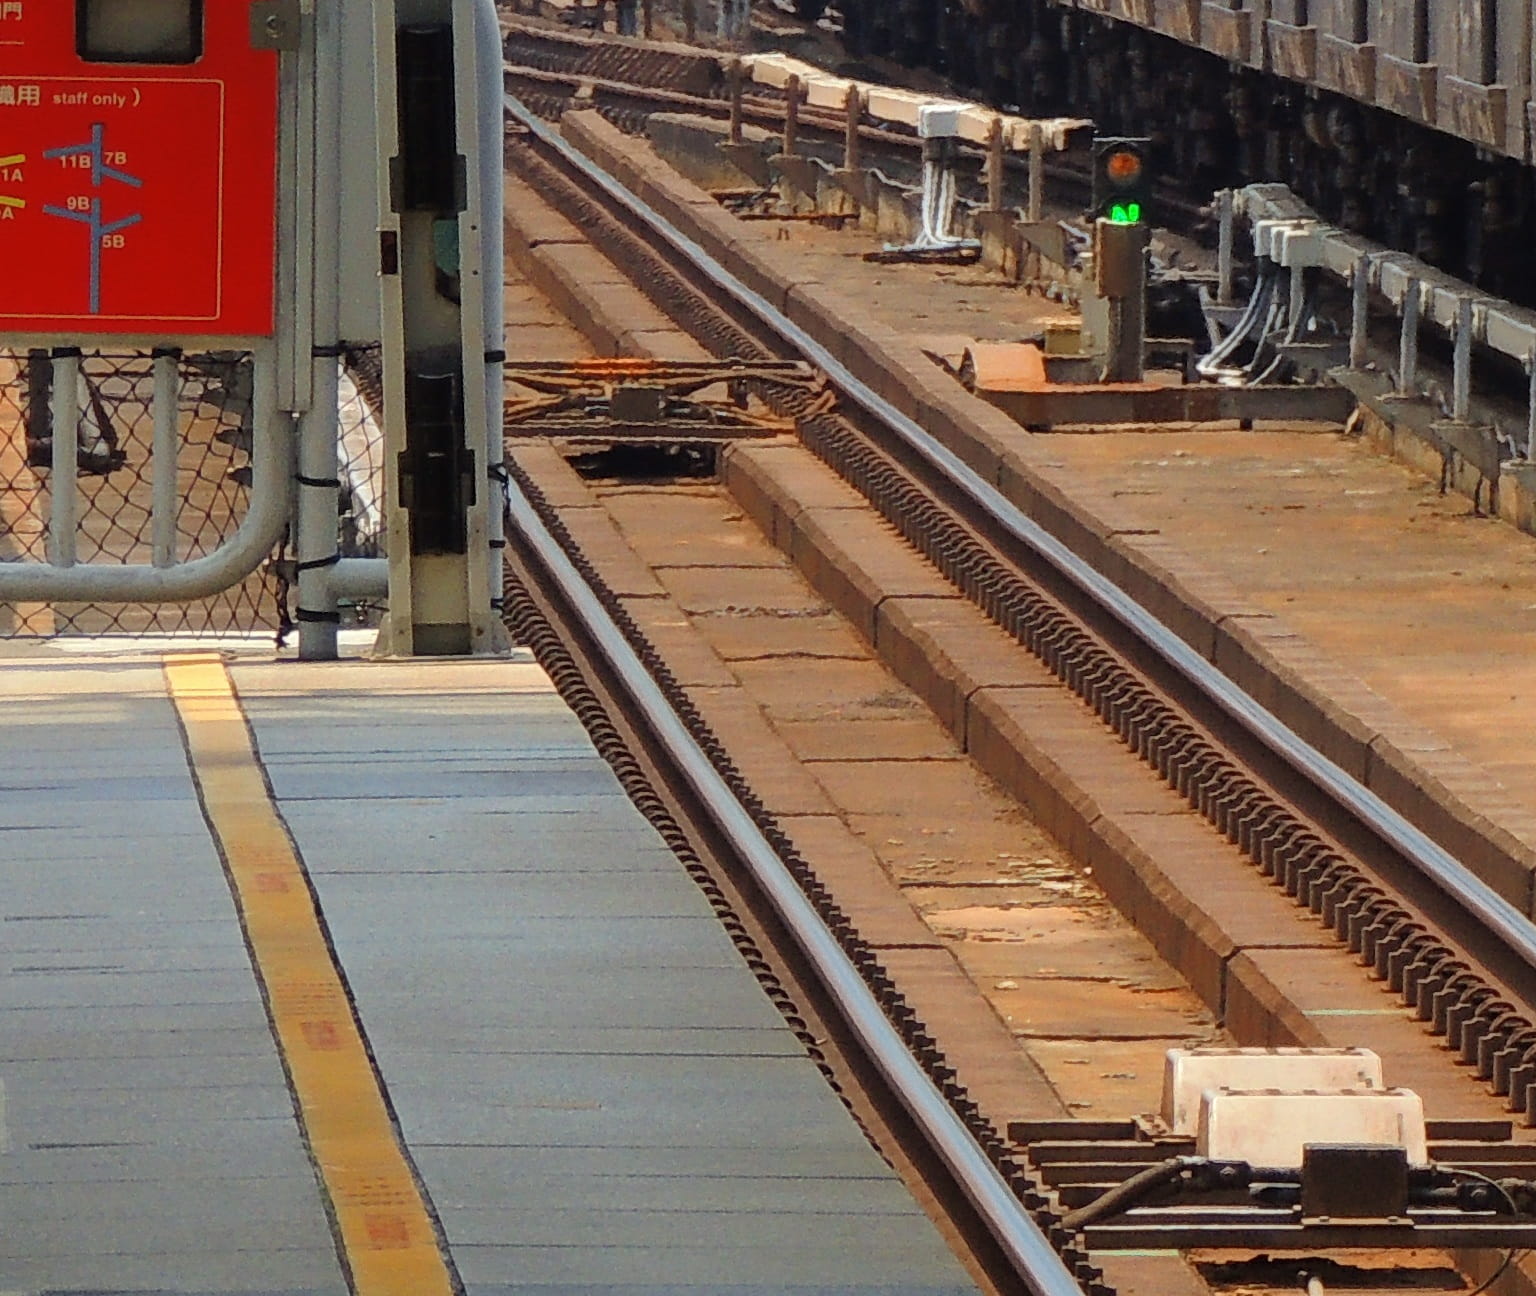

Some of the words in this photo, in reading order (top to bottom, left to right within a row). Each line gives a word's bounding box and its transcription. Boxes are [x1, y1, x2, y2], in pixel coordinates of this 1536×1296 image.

[53, 92, 88, 105] staff
[92, 93, 126, 108] only
[60, 155, 91, 168] 11B
[104, 151, 128, 165] 7B
[66, 196, 90, 210] 9B
